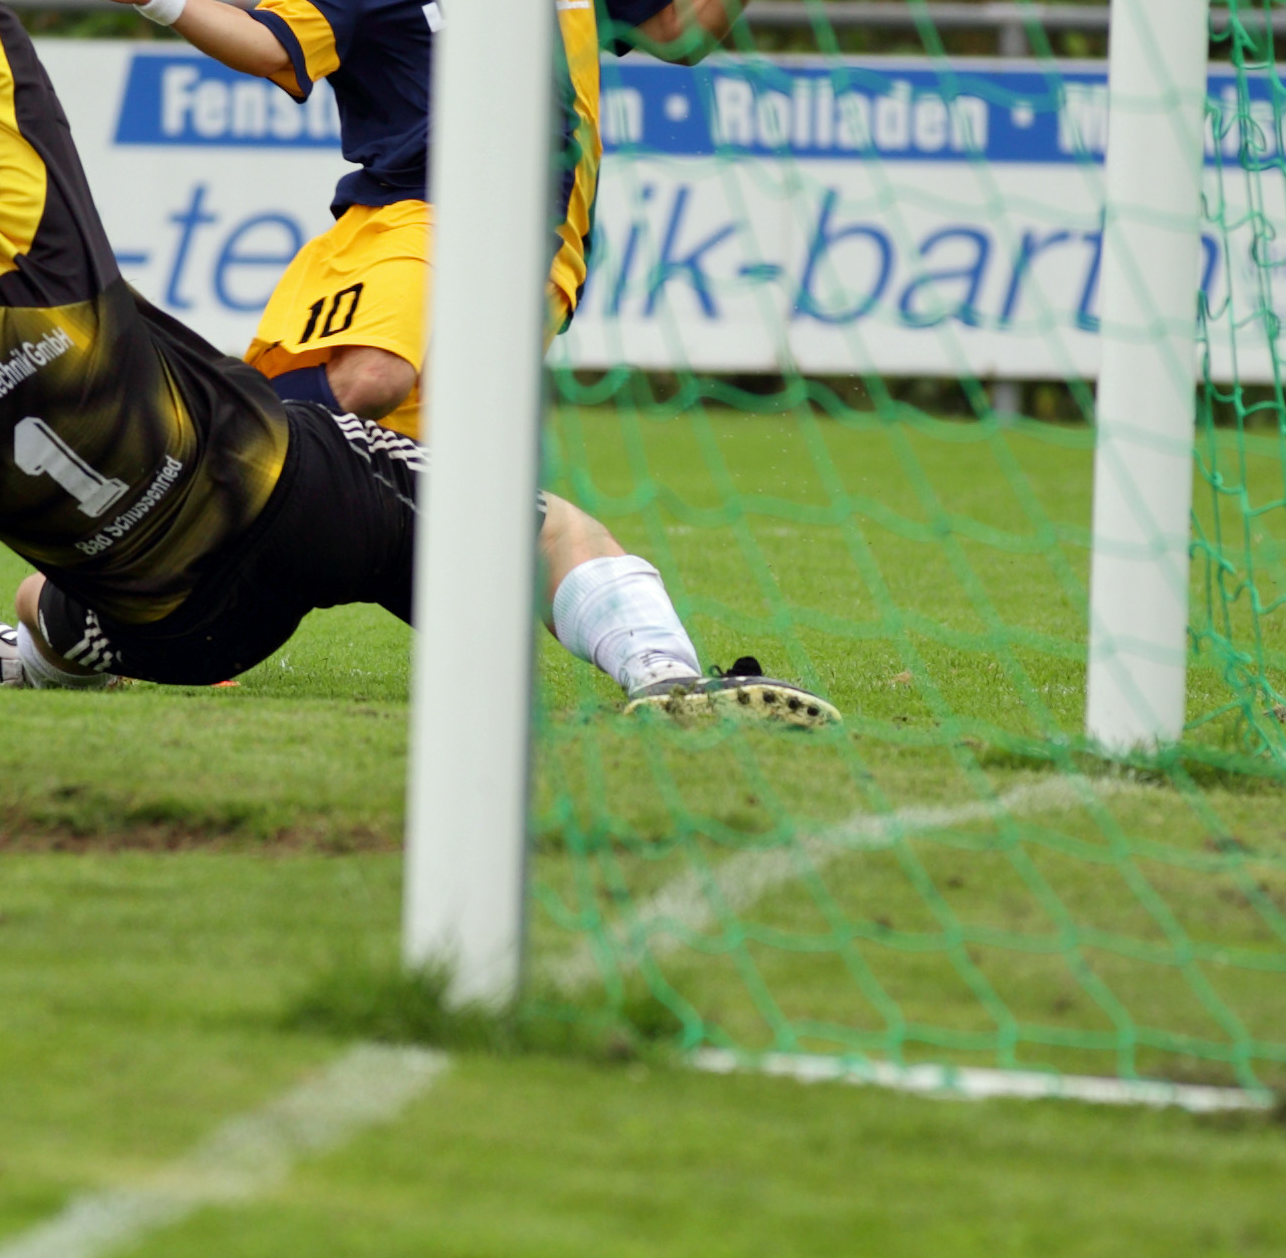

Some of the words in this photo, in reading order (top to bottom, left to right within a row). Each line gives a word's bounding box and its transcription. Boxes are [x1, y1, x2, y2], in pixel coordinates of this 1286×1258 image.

[161, 64, 342, 139] Fenst
[712, 77, 990, 152] Rolladen
[22, 326, 75, 366] GmbH
[296, 281, 364, 345] 10
[14, 416, 129, 518] 1
